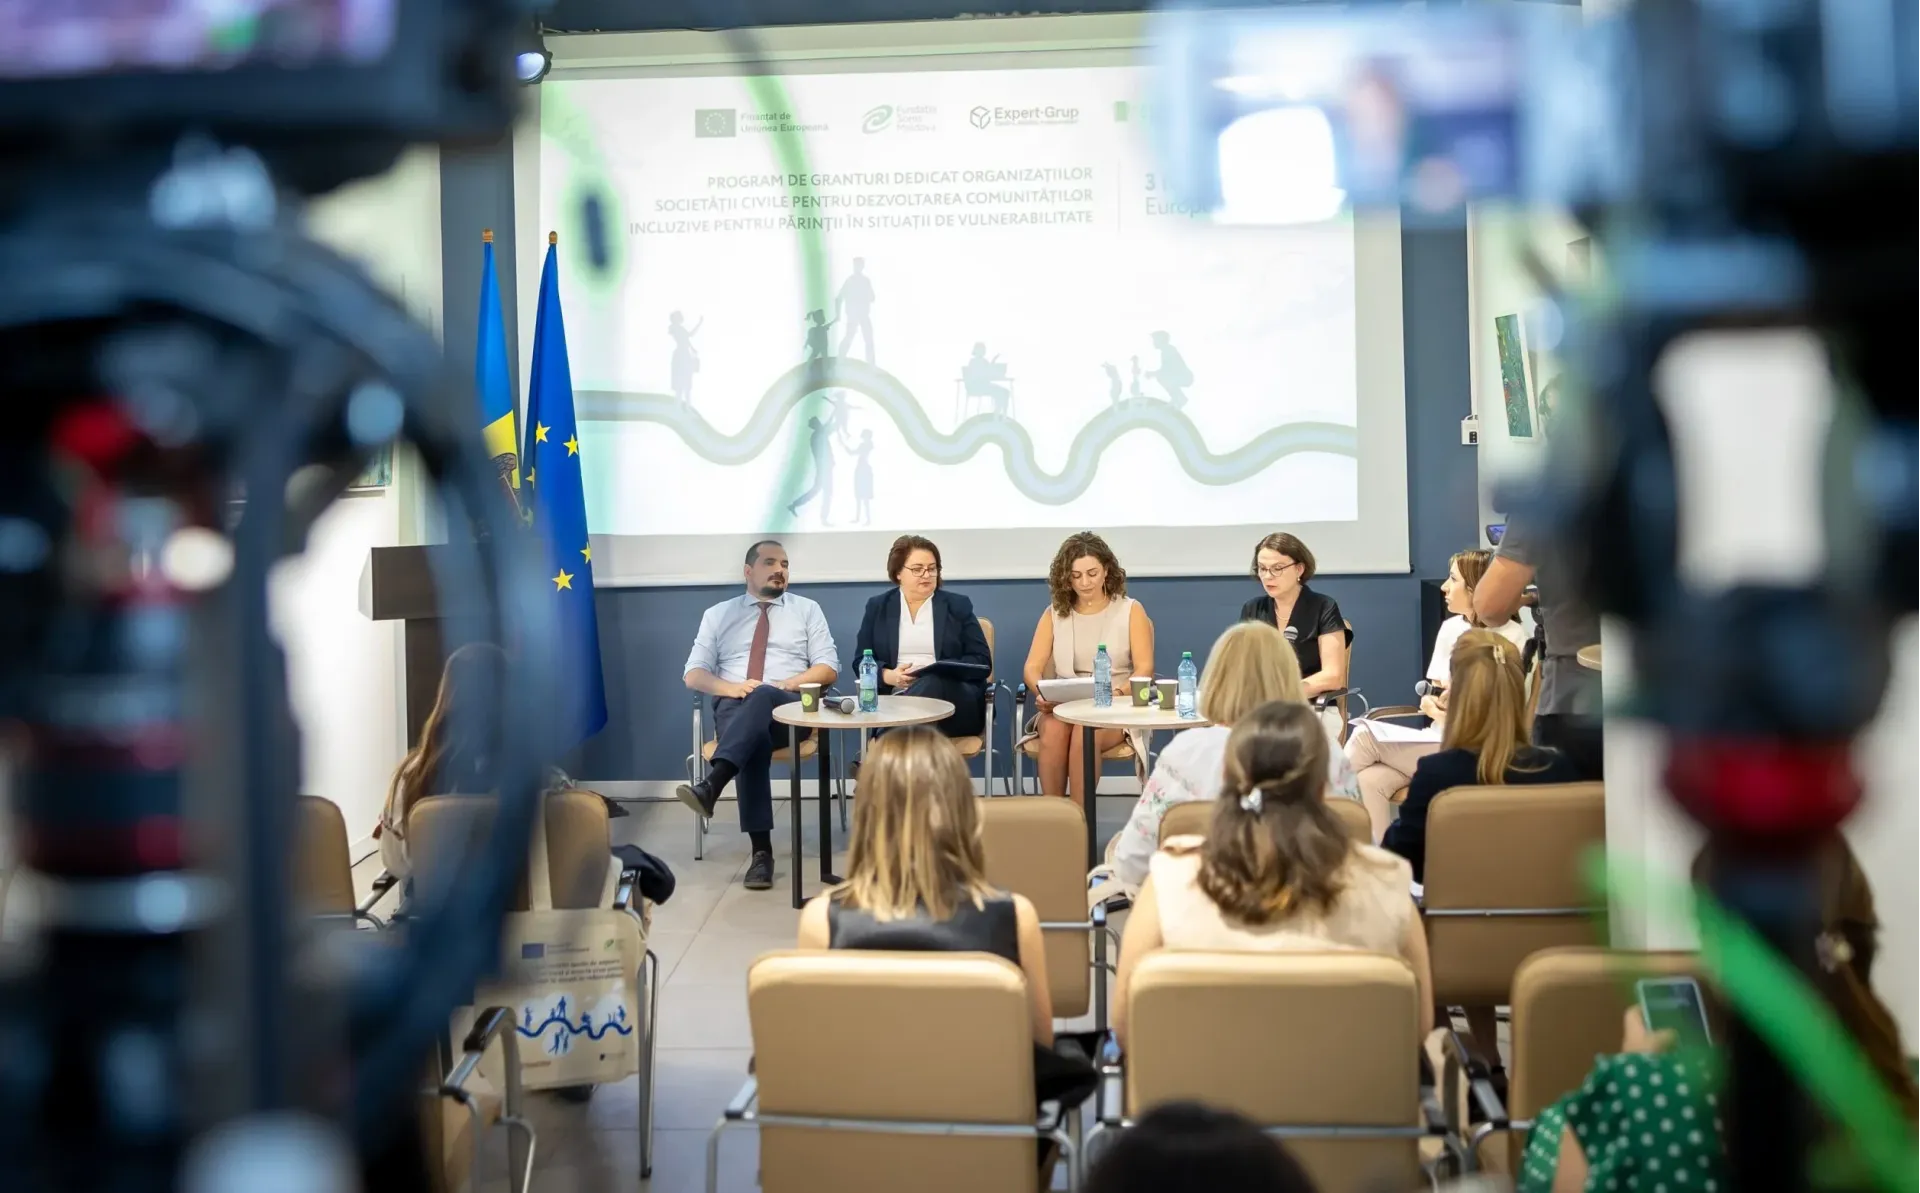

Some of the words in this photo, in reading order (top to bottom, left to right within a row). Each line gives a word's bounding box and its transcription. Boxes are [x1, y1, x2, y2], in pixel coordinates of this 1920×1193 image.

[780, 111, 791, 120] de
[741, 124, 777, 133] Uniunea
[708, 174, 783, 189] PROGRAM
[788, 173, 807, 187] DE
[811, 172, 890, 186] GRANTURI
[894, 170, 958, 185] DEDICAT
[962, 167, 1093, 183] ORGANIZAȚIILOR
[1145, 173, 1156, 191] 3
[741, 196, 789, 209] CIVILE
[792, 194, 852, 208] PENTRU
[856, 192, 963, 207] DEZVOLTAREA
[965, 187, 1093, 205] COMUNITĂȚILOR
[630, 220, 709, 234] INCLUZIVE
[714, 217, 774, 232] PENTRU
[778, 213, 843, 232] PĂRINȚII
[847, 213, 864, 228] ÎN
[868, 213, 931, 230] SITUAȚII
[935, 214, 954, 227] DE
[957, 211, 1093, 226] VULNERABILITATE
